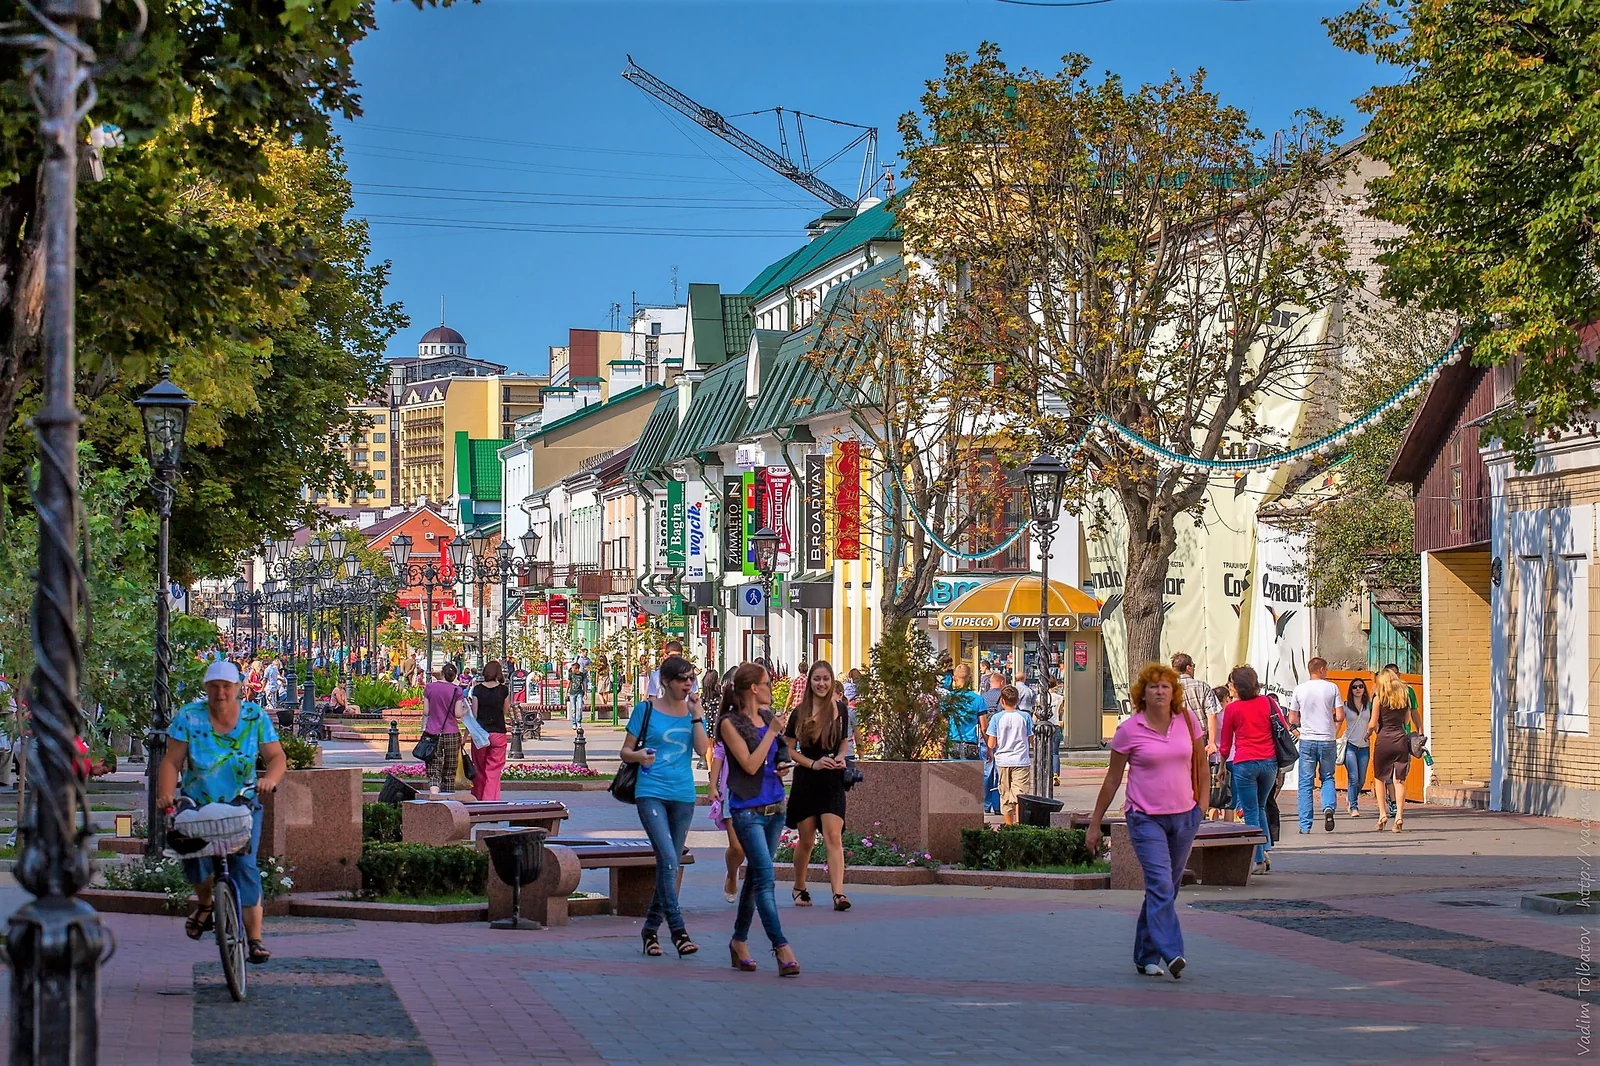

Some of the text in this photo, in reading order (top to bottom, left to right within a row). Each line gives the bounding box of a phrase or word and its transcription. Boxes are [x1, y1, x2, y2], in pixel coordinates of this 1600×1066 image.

[671, 503, 685, 546] Bagira
[811, 462, 821, 561] BROADWAY
[954, 617, 994, 626] ПРЕССА
[1022, 617, 1070, 626] ПРССА
